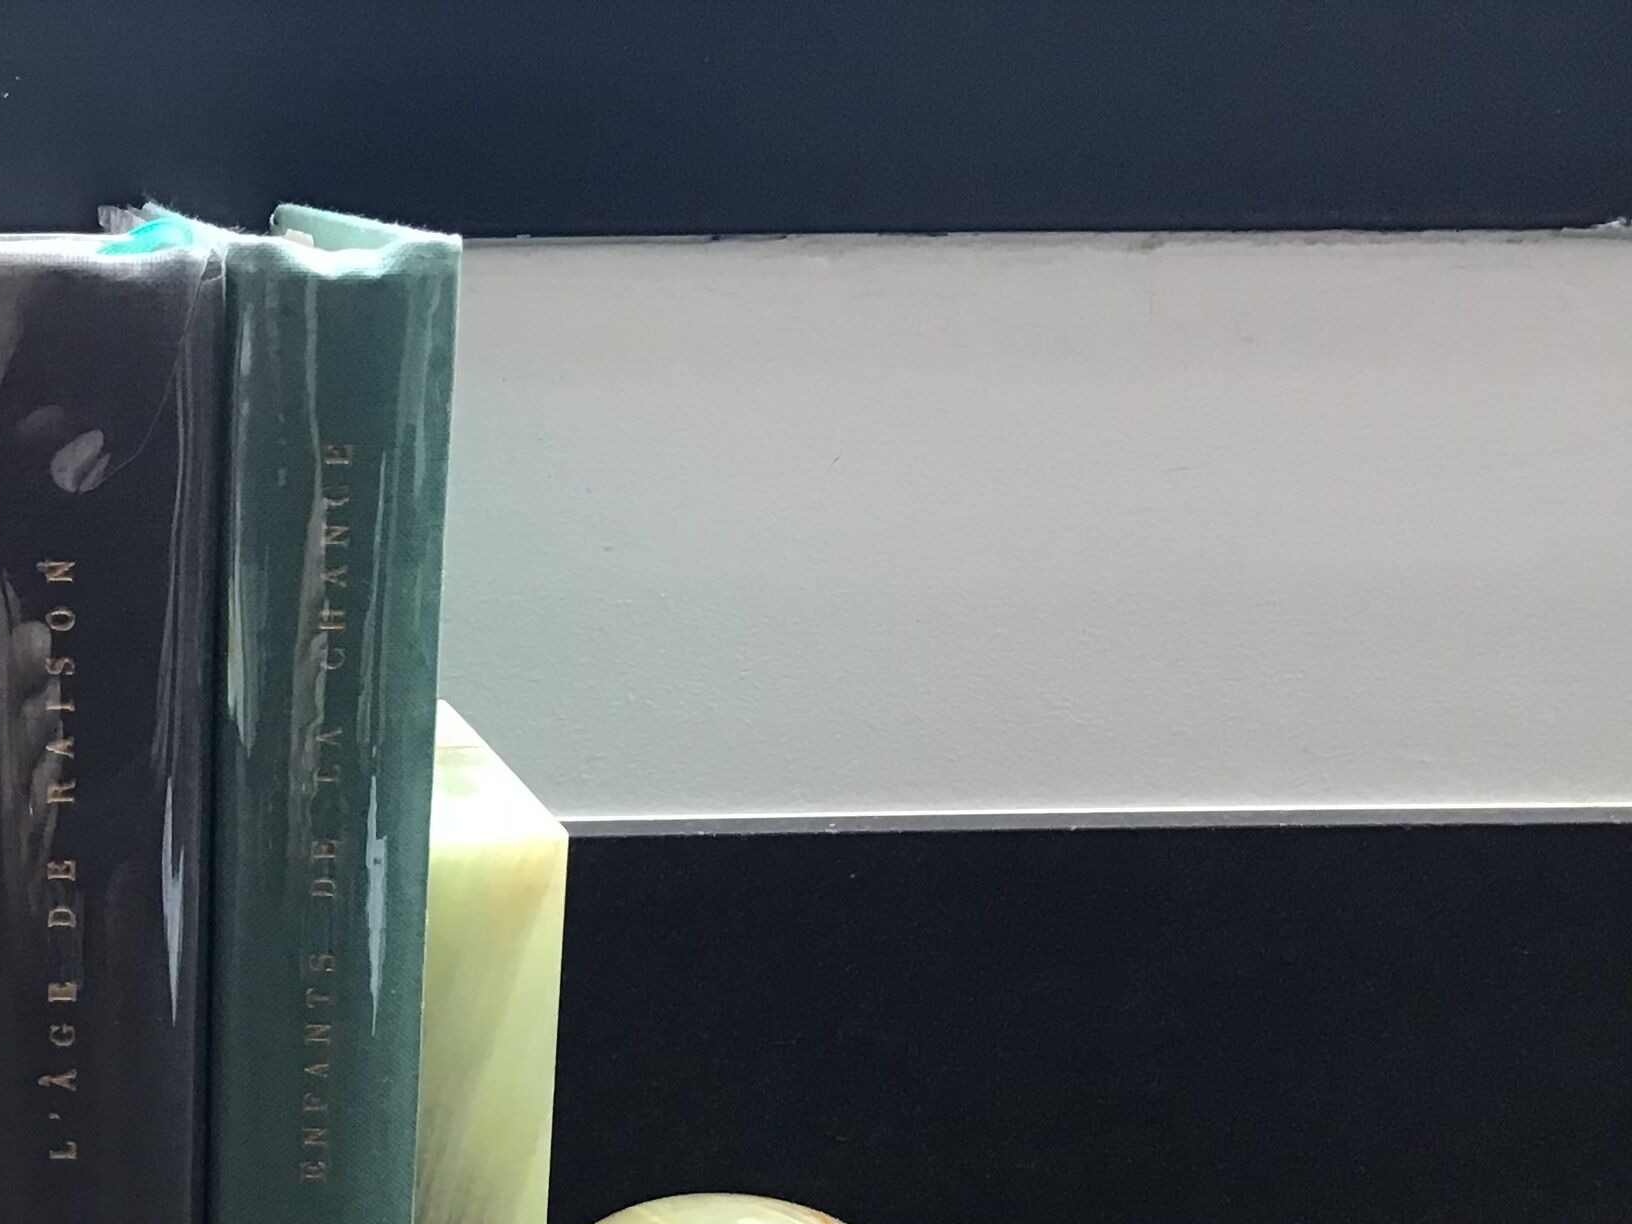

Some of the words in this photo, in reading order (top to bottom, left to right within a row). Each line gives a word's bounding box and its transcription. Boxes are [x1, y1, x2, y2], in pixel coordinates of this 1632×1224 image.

[318, 444, 353, 670] CHANCE
[39, 559, 77, 804] RAISON
[314, 727, 342, 782] LA
[46, 859, 77, 928] DE
[311, 839, 340, 897] DE
[299, 952, 336, 1182] ENFANTS
